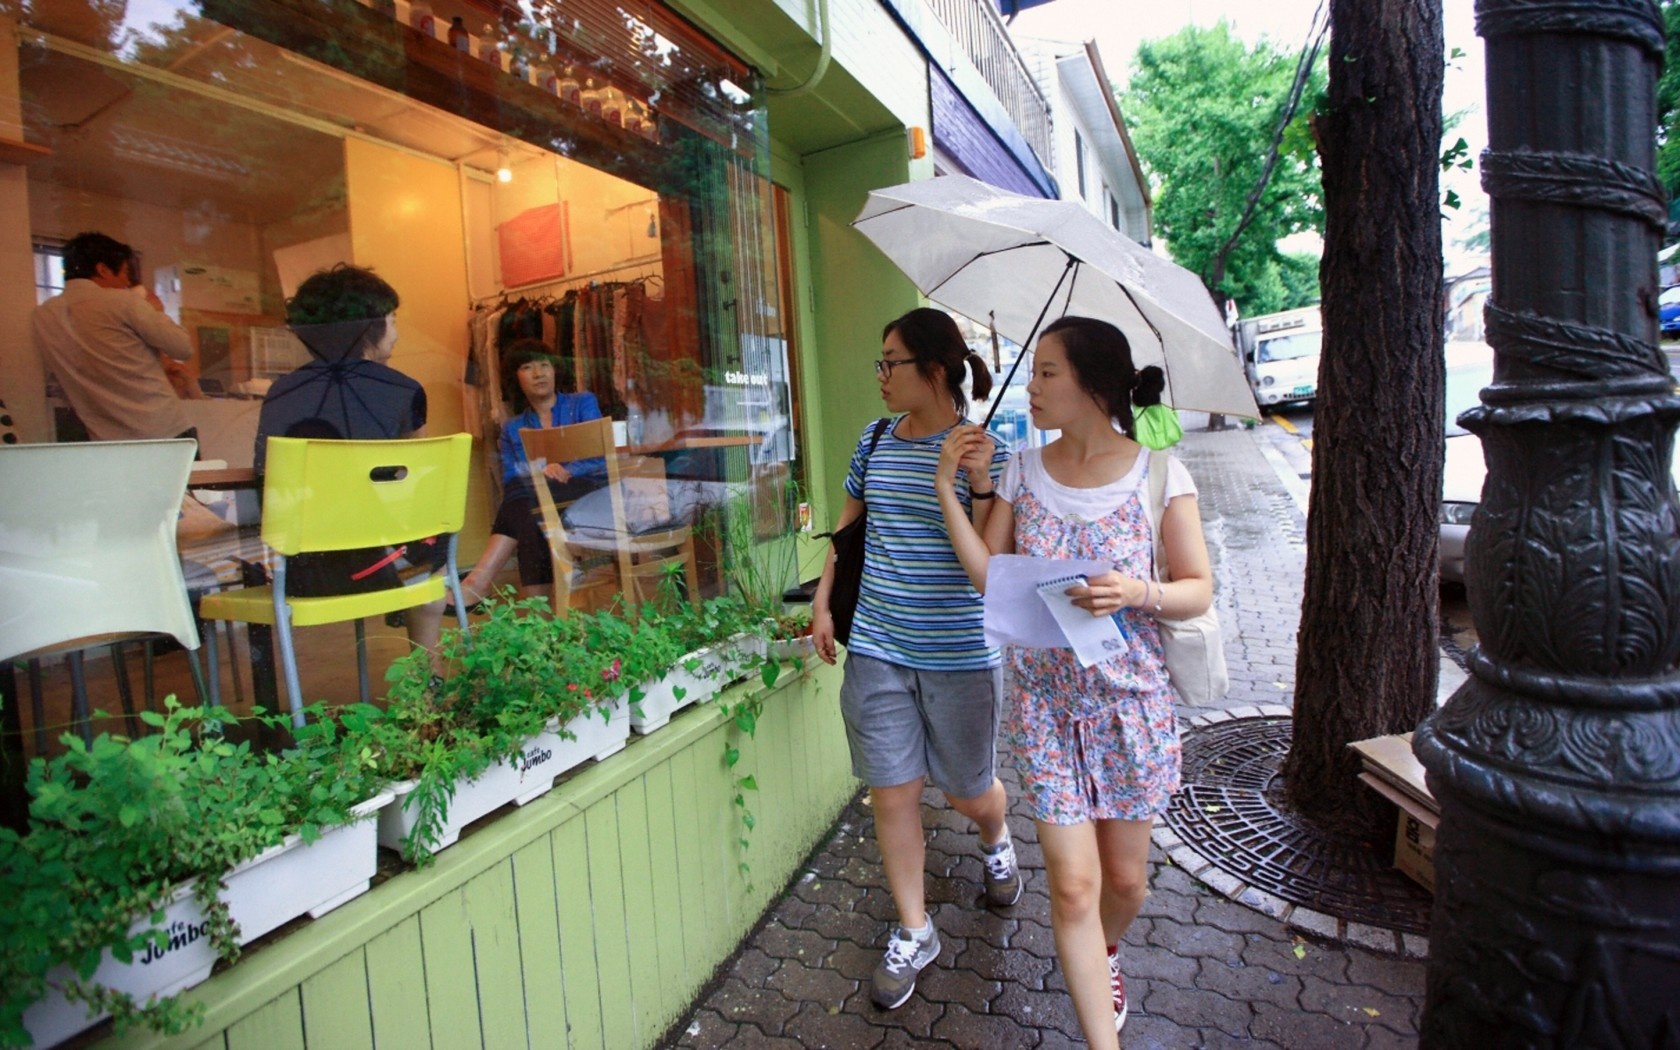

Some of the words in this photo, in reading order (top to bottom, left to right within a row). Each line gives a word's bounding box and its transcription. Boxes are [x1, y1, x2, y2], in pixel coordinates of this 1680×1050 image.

[725, 371, 749, 384] take
[750, 374, 768, 386] out
[521, 749, 552, 772] Jumbo
